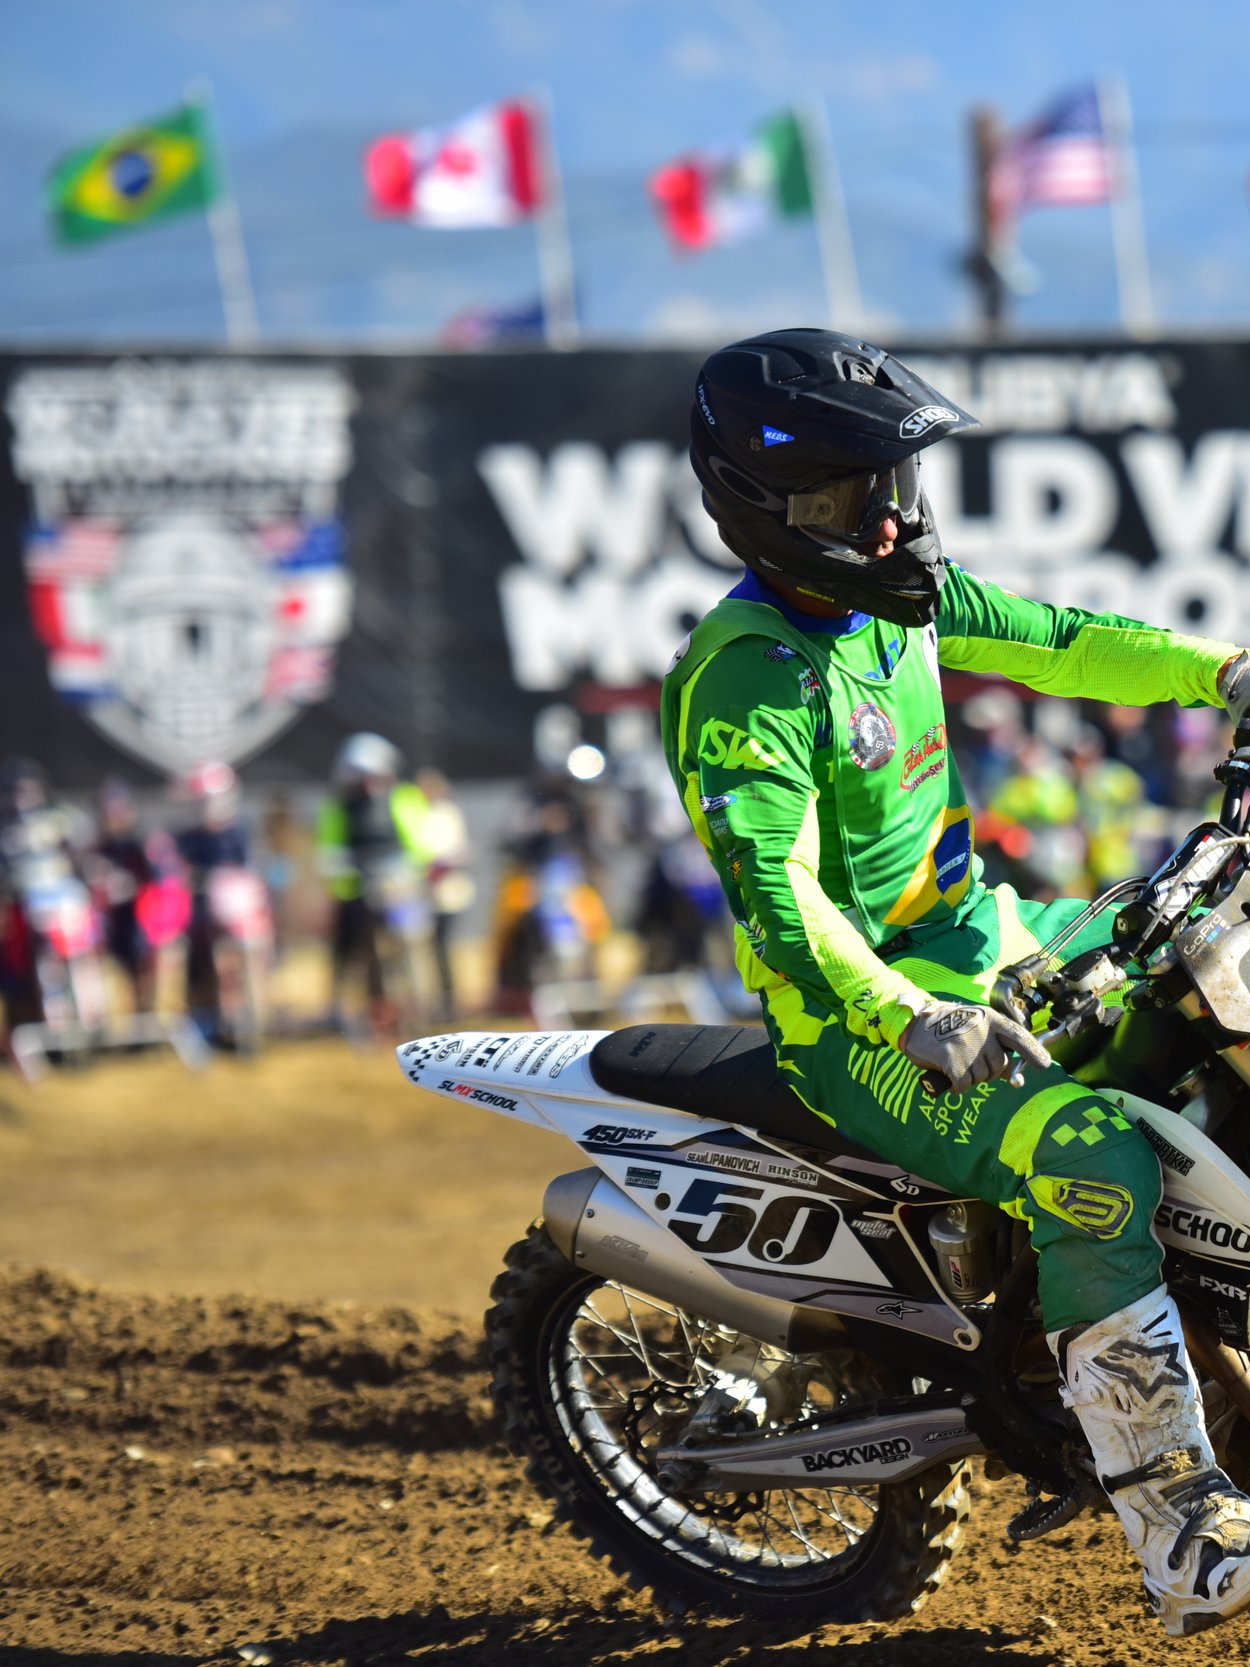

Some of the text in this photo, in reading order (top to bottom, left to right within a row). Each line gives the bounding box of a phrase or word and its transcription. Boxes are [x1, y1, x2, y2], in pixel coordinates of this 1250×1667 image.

[904, 406, 958, 434] SHOEI
[1183, 914, 1222, 955] GoPro
[437, 1079, 519, 1111] SLMXSCHOOL
[953, 1081, 998, 1144] WEAR
[766, 1163, 819, 1183] HINSON
[667, 1178, 841, 1266] 50
[1199, 1275, 1247, 1301] FXR
[799, 1438, 912, 1473] BACKYARD
[880, 1453, 910, 1465] DESIGN
